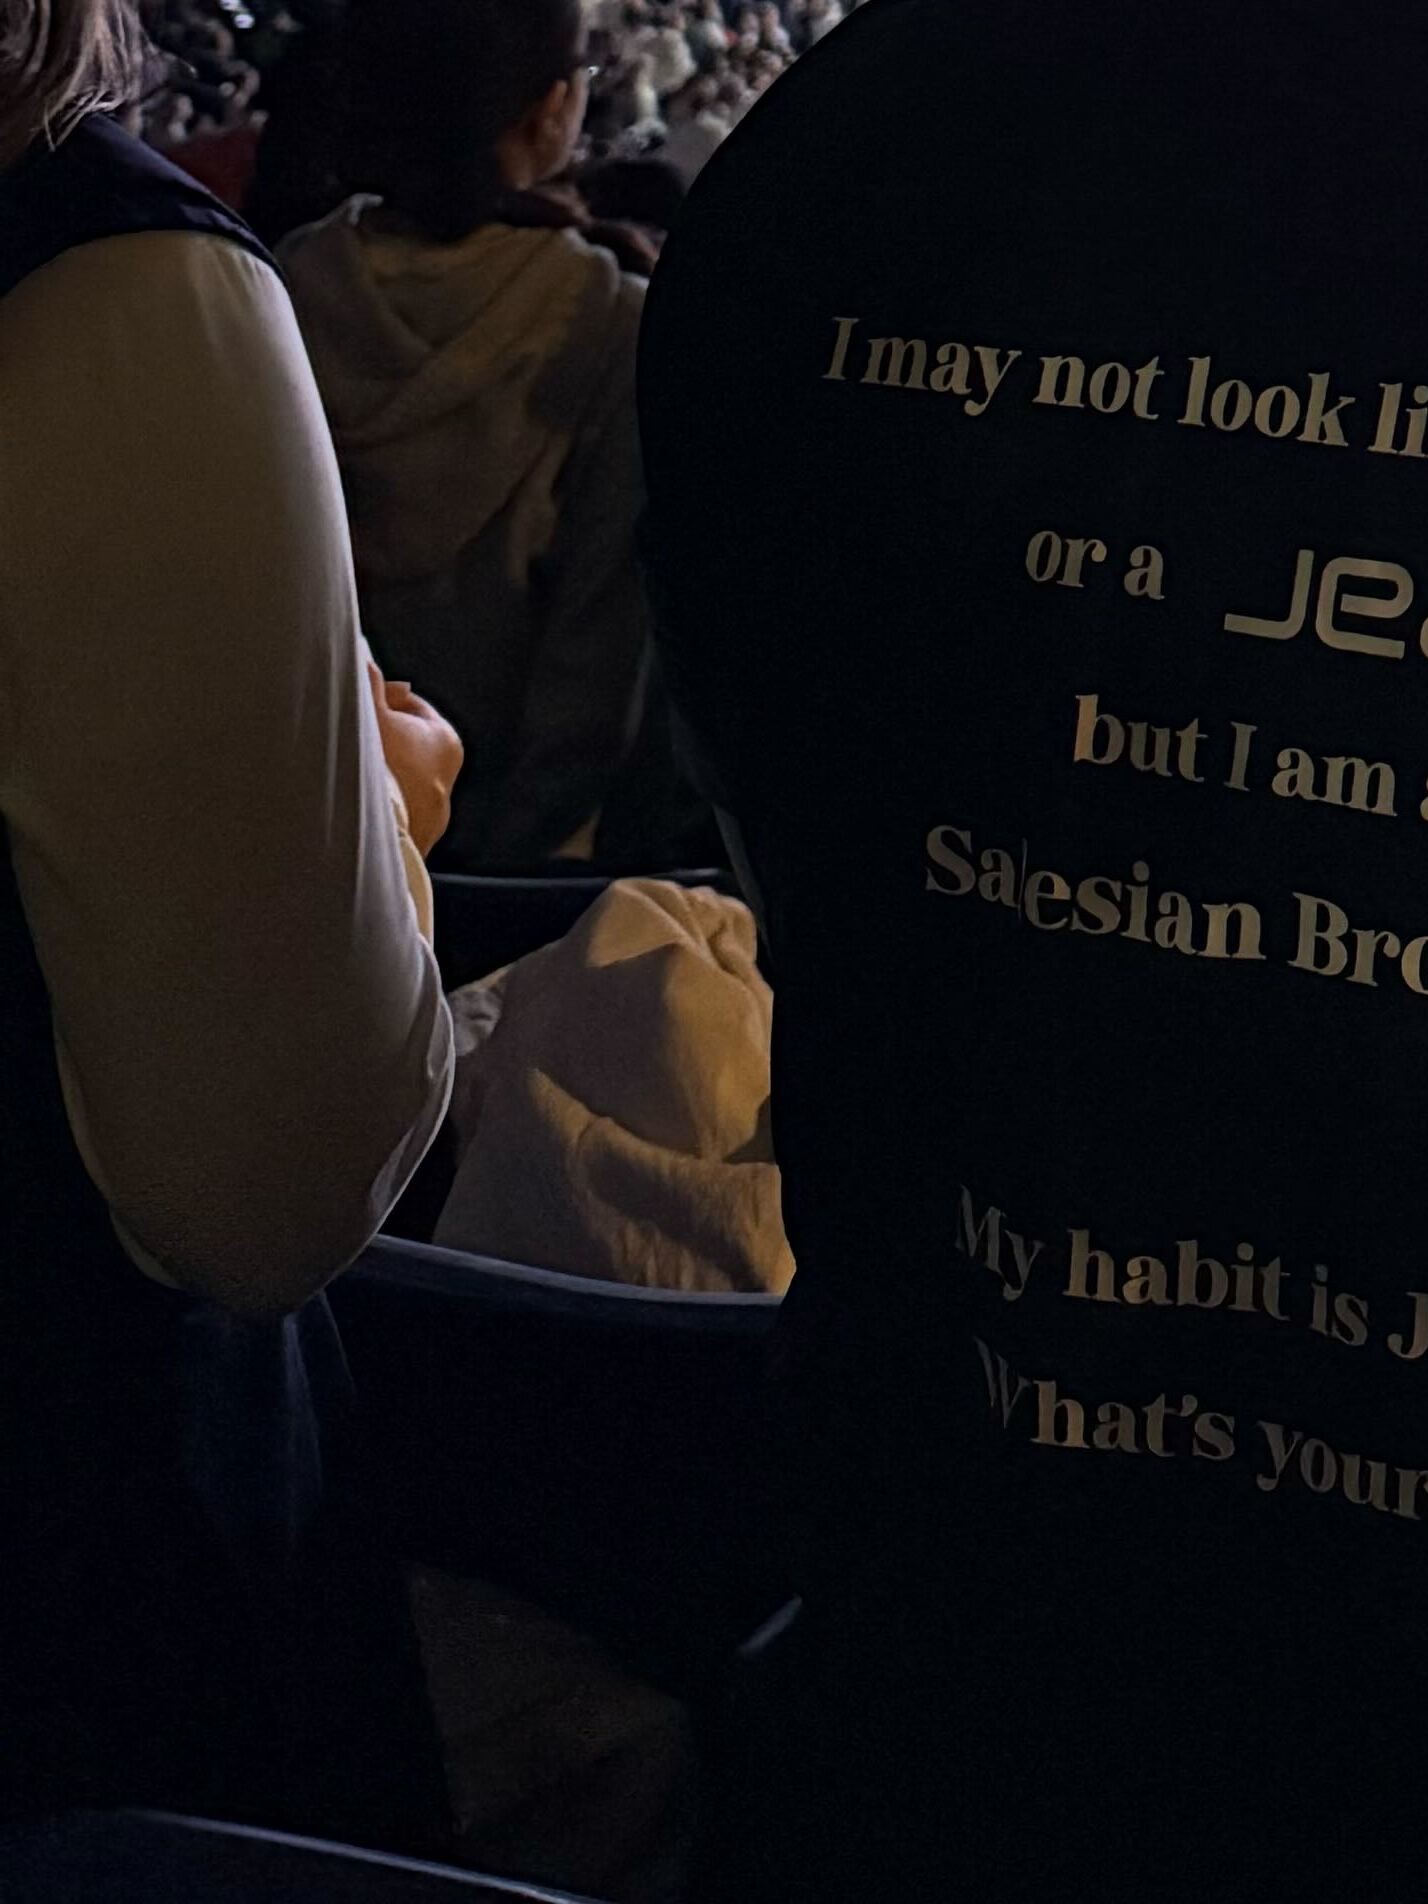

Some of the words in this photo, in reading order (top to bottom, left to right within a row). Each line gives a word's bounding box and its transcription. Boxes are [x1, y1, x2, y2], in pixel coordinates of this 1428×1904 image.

[823, 315, 861, 381] I
[861, 337, 1023, 417] may
[1033, 355, 1165, 420] not
[1176, 355, 1356, 447] look
[1025, 529, 1108, 588] or
[1123, 545, 1166, 601] a
[1073, 693, 1209, 783] but
[1223, 720, 1258, 792] I
[1271, 747, 1398, 818] am
[925, 824, 1267, 961] Saesian
[955, 1184, 1044, 1301] My
[1063, 1228, 1291, 1322] habit
[1308, 1262, 1370, 1346] is
[974, 1336, 1235, 1462] What's
